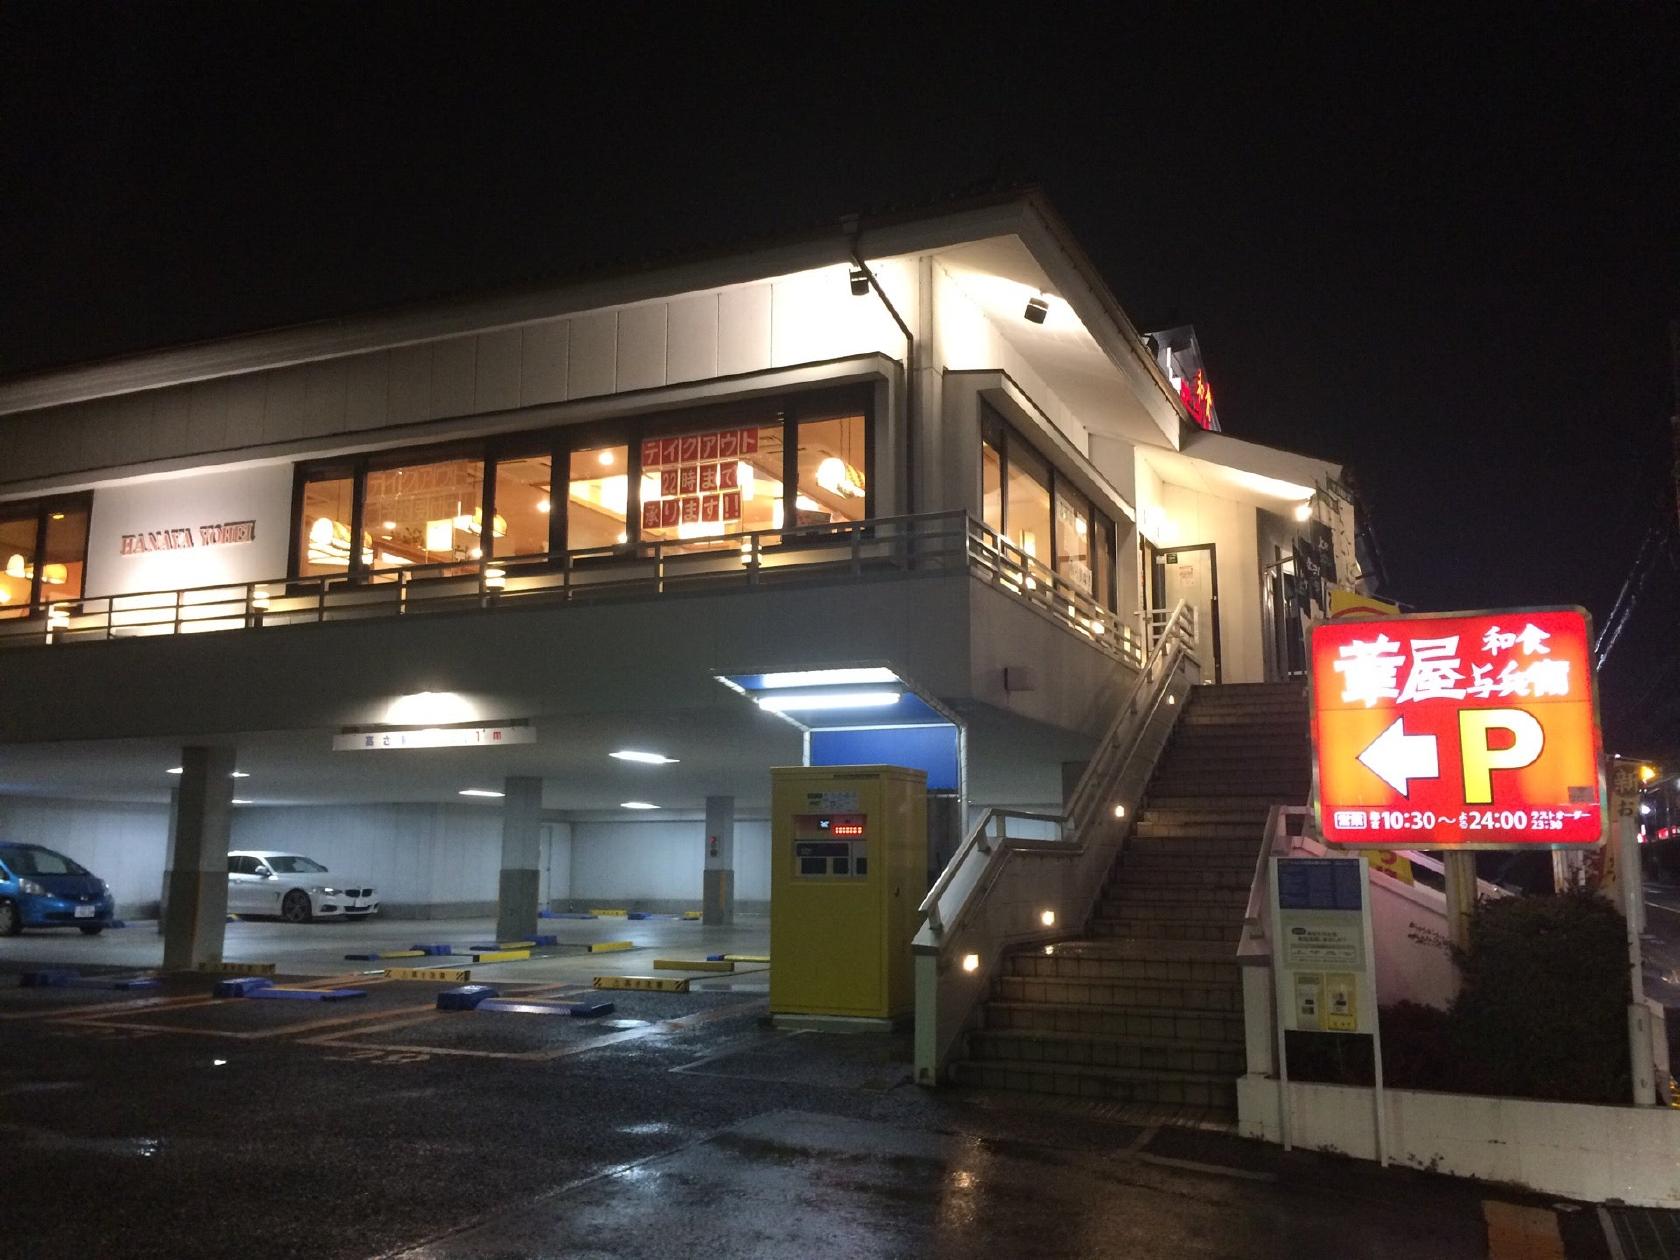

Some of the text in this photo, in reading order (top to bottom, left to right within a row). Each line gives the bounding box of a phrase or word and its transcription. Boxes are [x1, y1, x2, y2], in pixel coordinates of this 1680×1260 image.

[645, 430, 756, 463] テイクアウト
[662, 464, 738, 494] 22時まで
[1481, 623, 1551, 655] 和食
[1333, 633, 1466, 708] 華屋
[1458, 707, 1545, 805] P
[1381, 811, 1436, 829] 10:30
[1469, 811, 1527, 829] 24:00
